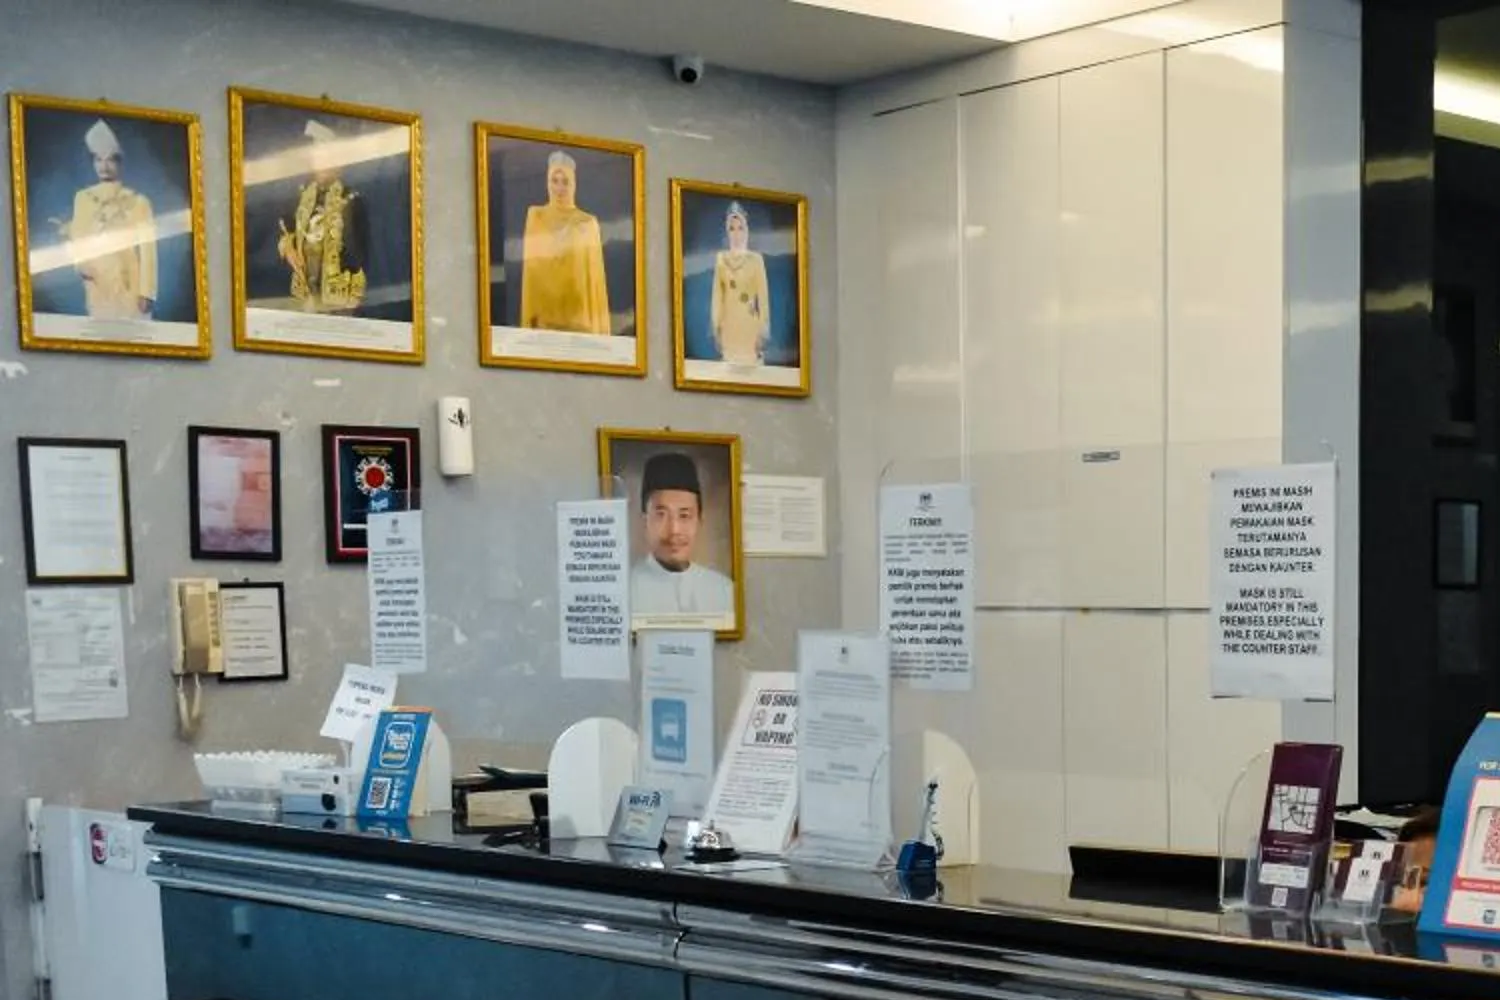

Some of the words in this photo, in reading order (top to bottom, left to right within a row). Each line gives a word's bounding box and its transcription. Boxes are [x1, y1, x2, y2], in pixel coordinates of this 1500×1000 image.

[1233, 487, 1267, 498] PREMIS
[1282, 486, 1313, 497] MASIH
[1241, 502, 1303, 513] MEWAJIBKAN
[1237, 532, 1307, 543] TERUTAMANYA
[1223, 548, 1262, 559] SEMASA
[1228, 563, 1268, 574] DENGAN
[1239, 588, 1266, 599] MASK
[1279, 587, 1305, 599] STILL
[1225, 602, 1284, 613] MANDATORY
[1285, 602, 1295, 612] IN
[1297, 602, 1319, 613] THIS
[1219, 615, 1266, 627] PREMISES
[1267, 615, 1325, 627] ESPECIALLY
[1223, 630, 1252, 640] WHILE
[1253, 629, 1294, 640] DEALING
[1296, 629, 1320, 640] WITH
[1222, 643, 1241, 653] THE
[1241, 643, 1287, 654] COUNTER
